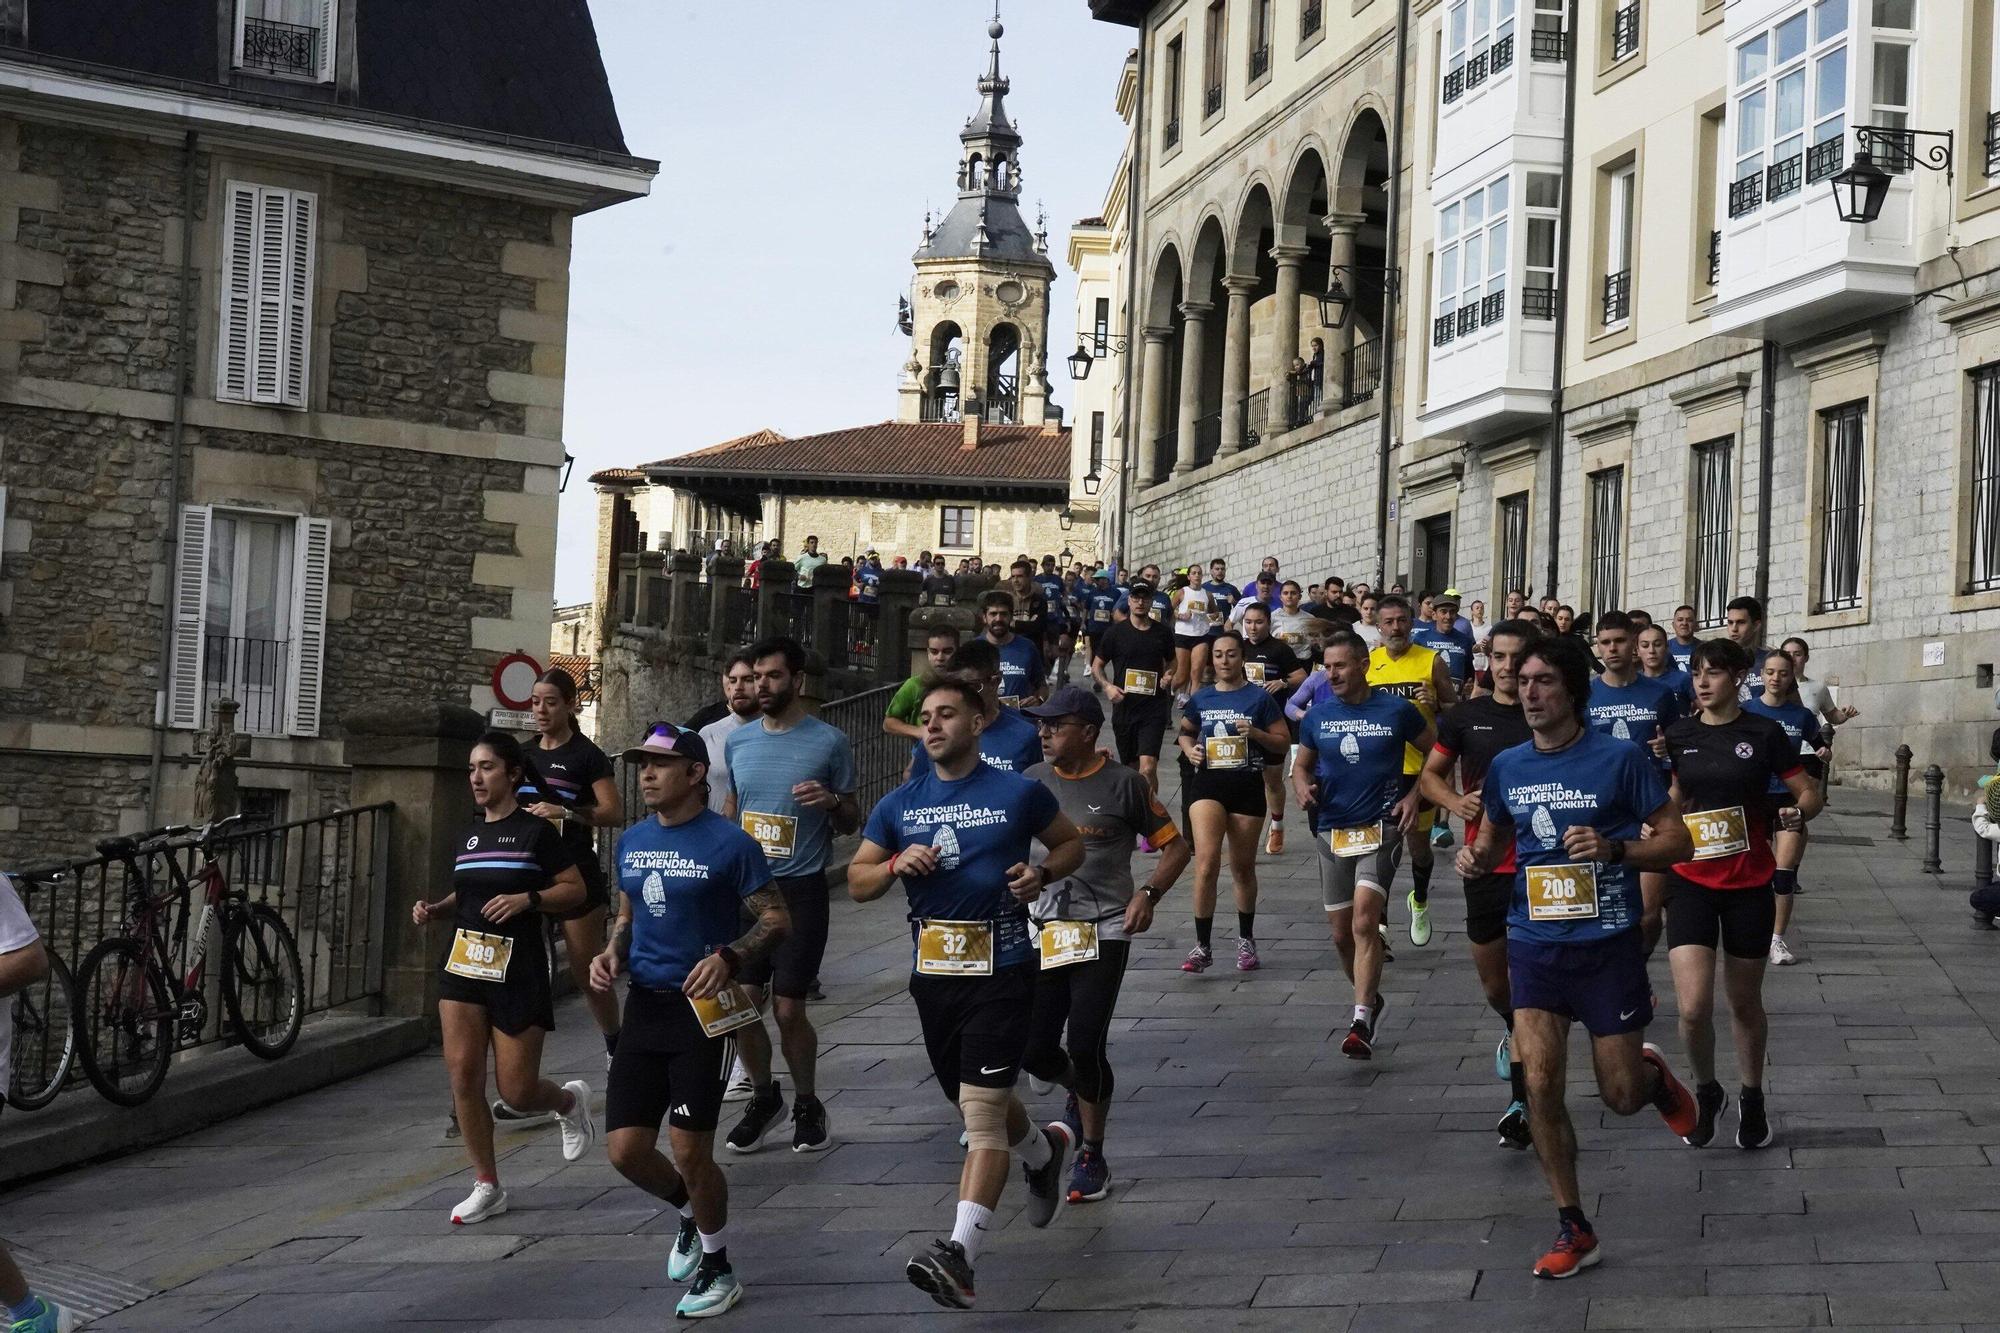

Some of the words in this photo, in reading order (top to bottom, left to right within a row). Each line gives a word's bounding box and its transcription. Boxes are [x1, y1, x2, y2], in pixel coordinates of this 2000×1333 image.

[1598, 704, 1636, 712] CONQUISTA
[1600, 708, 1649, 718] ALMENDRA
[1330, 724, 1382, 732] ALMENDRA
[1216, 744, 1236, 756] 507
[1517, 783, 1563, 795] CONQUISTA
[1518, 790, 1583, 805] ALMENDRA
[915, 804, 971, 816] CONQUISTA
[1550, 800, 1597, 810] KONKISTA
[916, 808, 992, 825] ALMENDRA
[956, 815, 1007, 829] KONKISTA
[754, 823, 781, 841] 588
[1348, 831, 1365, 843] 33
[1699, 821, 1730, 841] 342
[633, 851, 679, 859] CONQUISTA
[632, 859, 696, 869] ALMENDRA
[664, 869, 709, 879] KONKISTA
[1542, 878, 1576, 899] 208
[943, 933, 967, 954] 32
[1052, 927, 1080, 949] 284
[466, 943, 495, 964] 489
